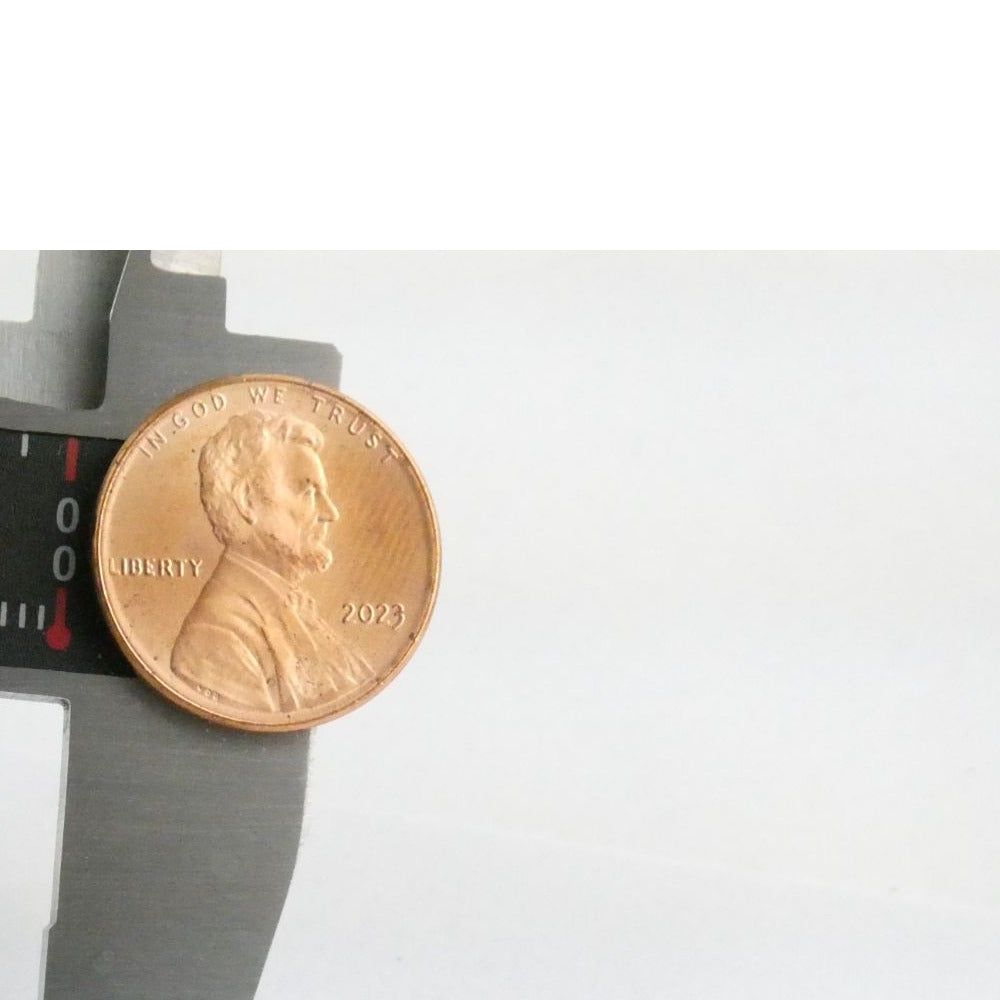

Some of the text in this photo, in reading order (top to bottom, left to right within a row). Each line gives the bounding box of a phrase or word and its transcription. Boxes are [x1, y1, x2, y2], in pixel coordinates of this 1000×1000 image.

[138, 387, 400, 464] IN GOD WE TRUST
[56, 496, 80, 533] 0
[52, 545, 76, 582] 0
[108, 557, 203, 578] LIBERTY
[341, 602, 406, 631] 2023
